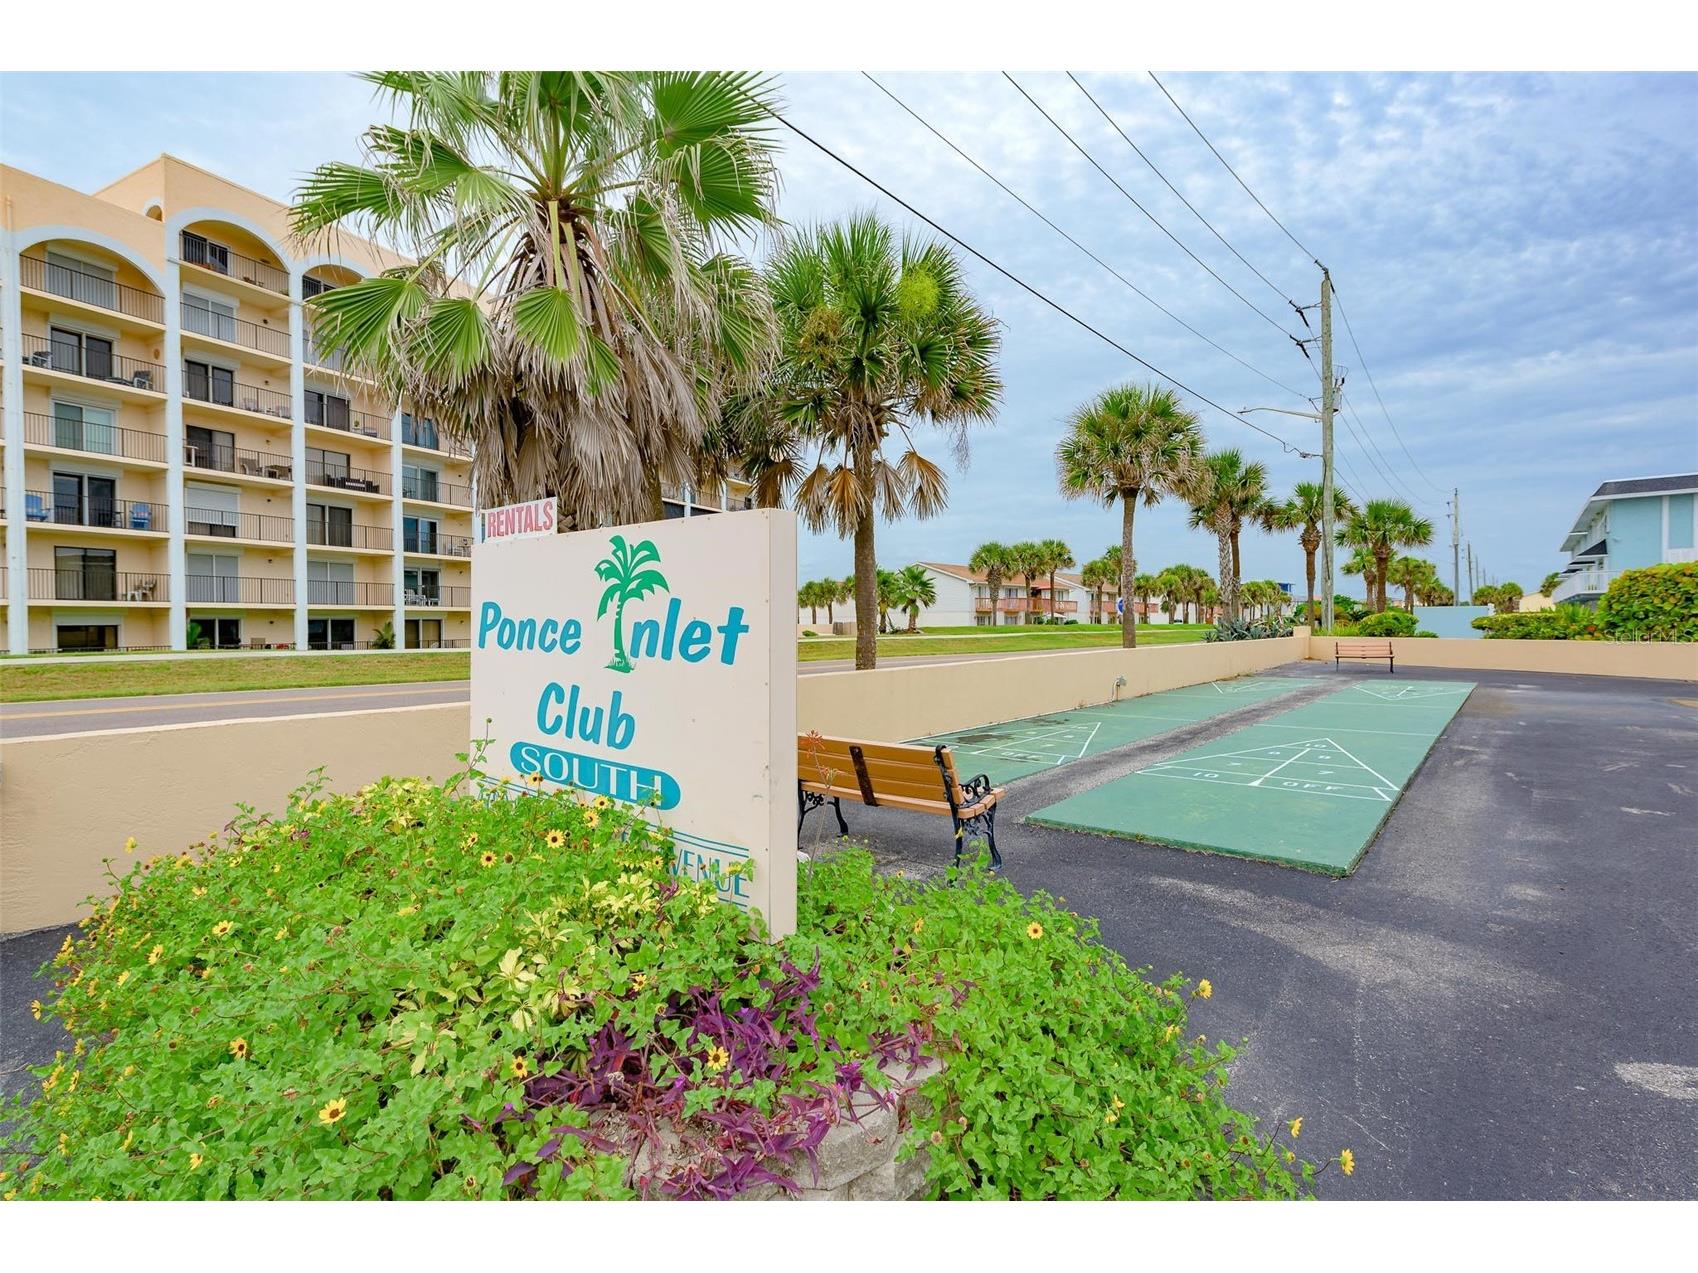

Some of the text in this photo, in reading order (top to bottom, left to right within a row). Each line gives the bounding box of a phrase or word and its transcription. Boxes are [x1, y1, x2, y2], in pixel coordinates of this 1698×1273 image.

[487, 500, 553, 538] RENTALS
[478, 600, 582, 655] Ponce
[537, 681, 635, 750] Club
[520, 746, 662, 806] SOUTH
